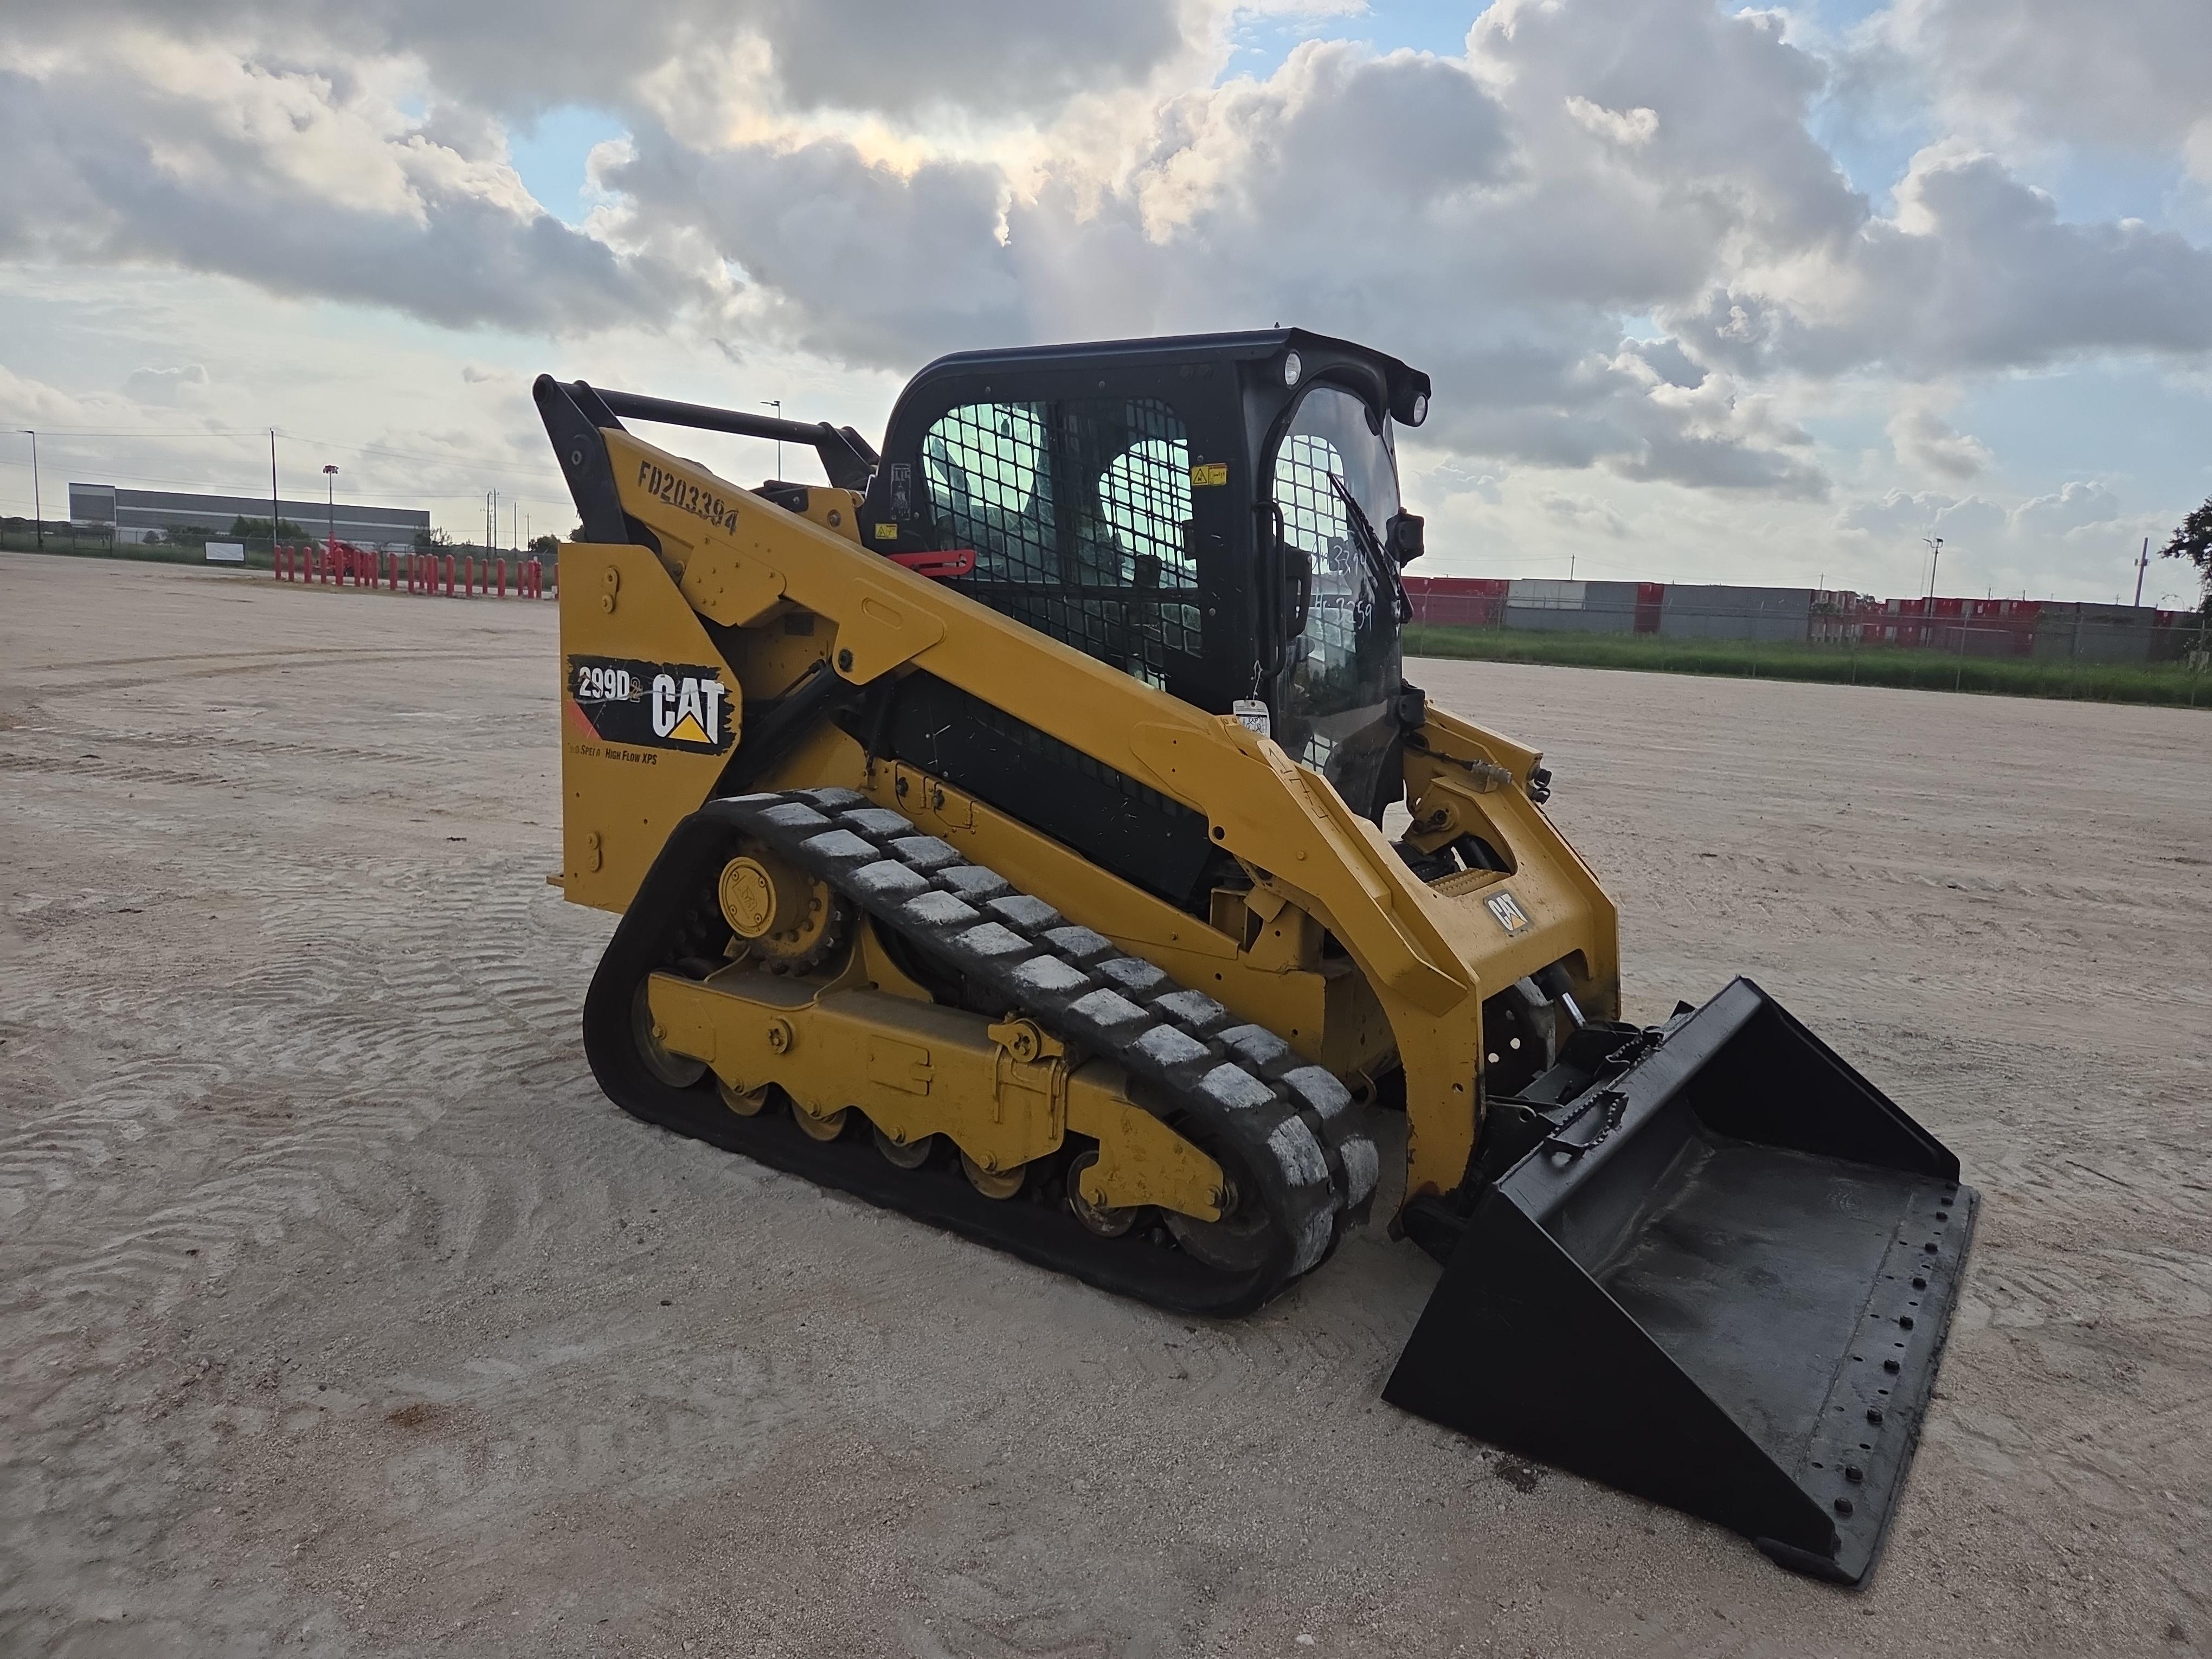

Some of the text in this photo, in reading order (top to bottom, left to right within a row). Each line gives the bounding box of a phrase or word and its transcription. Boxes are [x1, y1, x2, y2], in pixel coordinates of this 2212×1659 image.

[638, 460, 740, 536] FD203394
[652, 673, 725, 744] CAT
[641, 753, 658, 766] XPS
[1488, 893, 1528, 931] CAT
